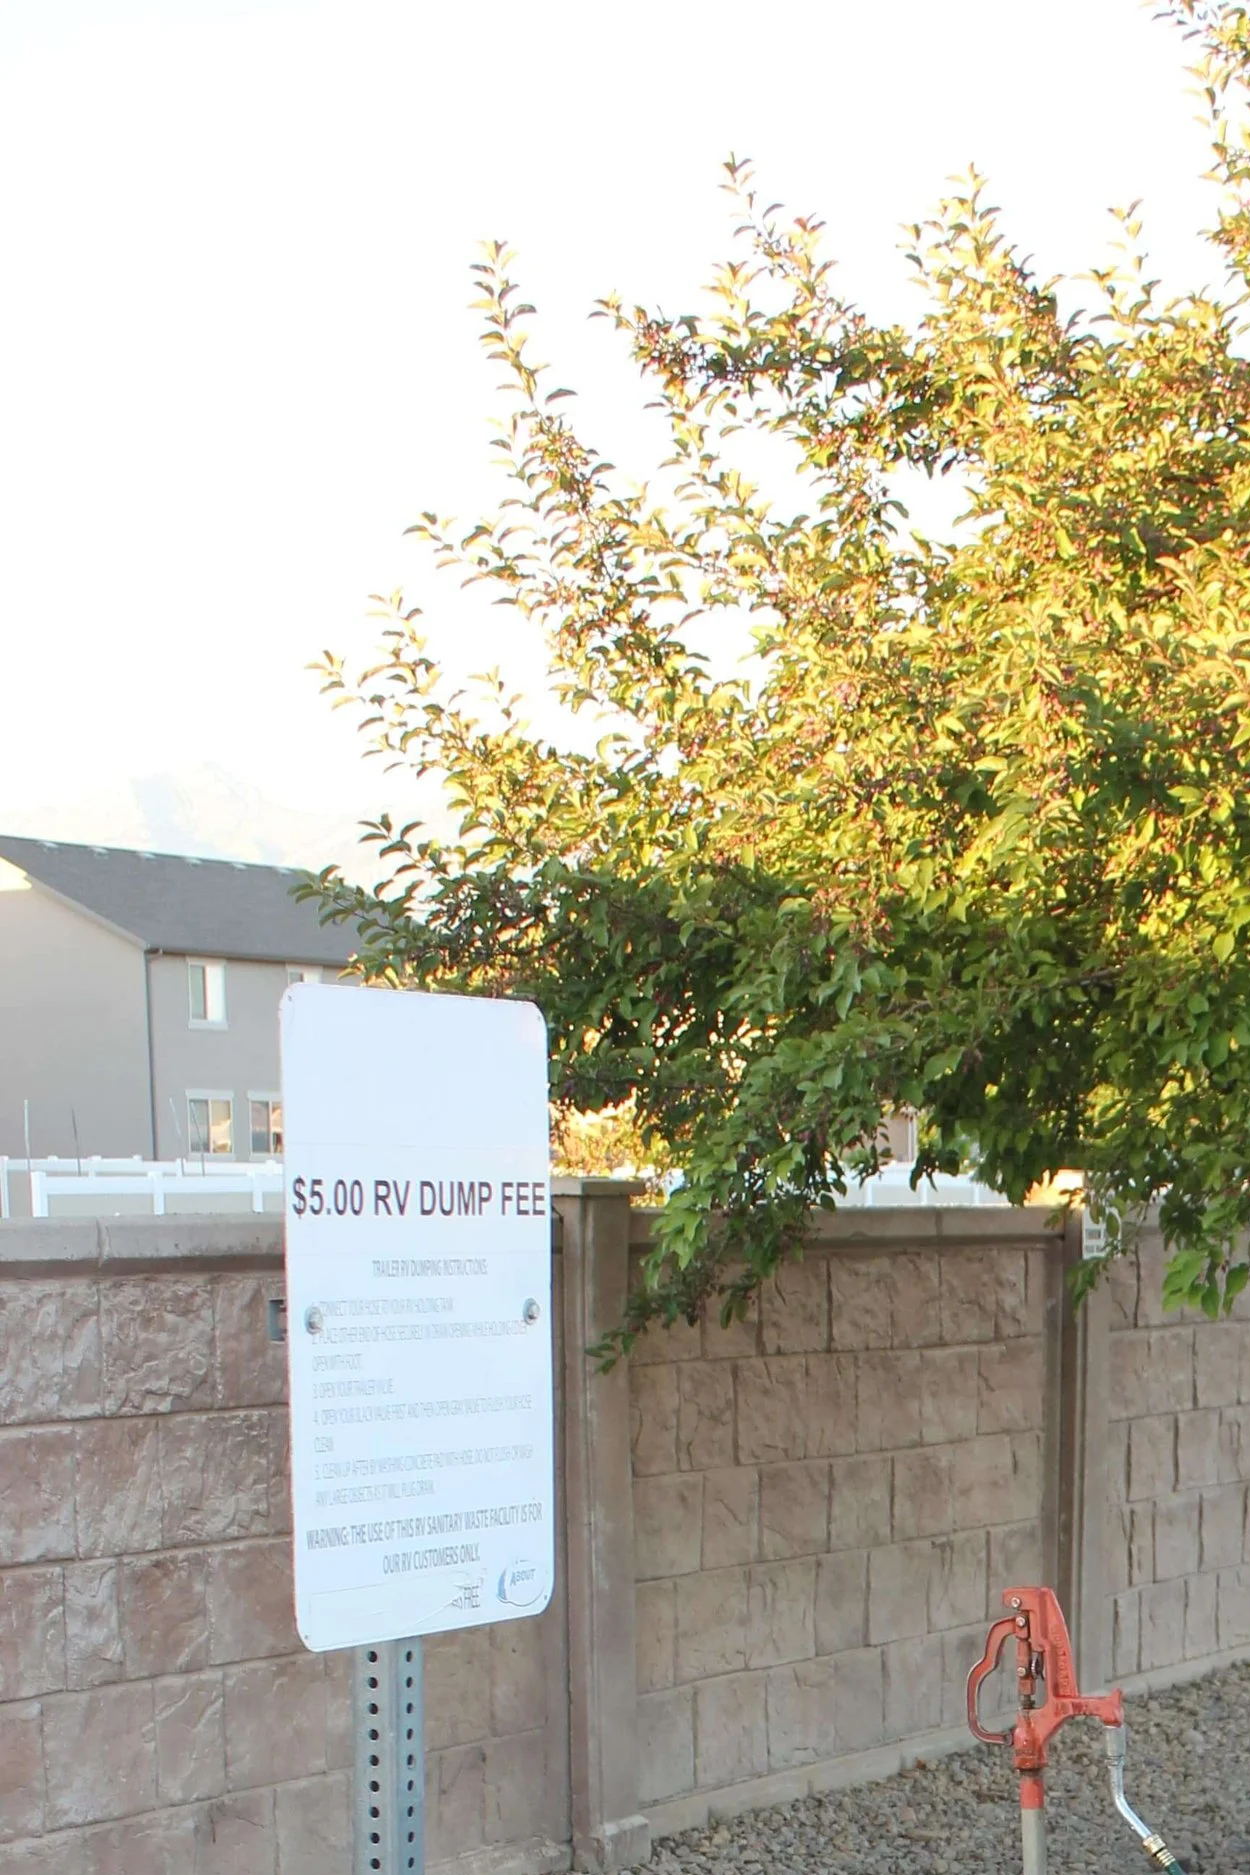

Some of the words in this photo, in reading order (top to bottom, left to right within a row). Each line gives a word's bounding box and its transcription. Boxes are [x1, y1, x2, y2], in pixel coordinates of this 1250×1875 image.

[292, 1175, 364, 1219] $5.00
[374, 1180, 411, 1217] RV
[419, 1180, 493, 1217] DUMP
[501, 1181, 546, 1216] FEE
[350, 1523, 366, 1545] THE
[367, 1521, 383, 1543] USE
[384, 1520, 395, 1541] OF
[396, 1517, 414, 1539] THIS
[415, 1516, 426, 1536] RV
[426, 1511, 462, 1535] SANITARY
[519, 1502, 527, 1523] IS
[528, 1500, 542, 1522] FOR
[383, 1552, 400, 1572] OUR
[401, 1550, 412, 1570] RV
[413, 1545, 459, 1569] CUSTOMERS
[463, 1585, 481, 1609] FREE
